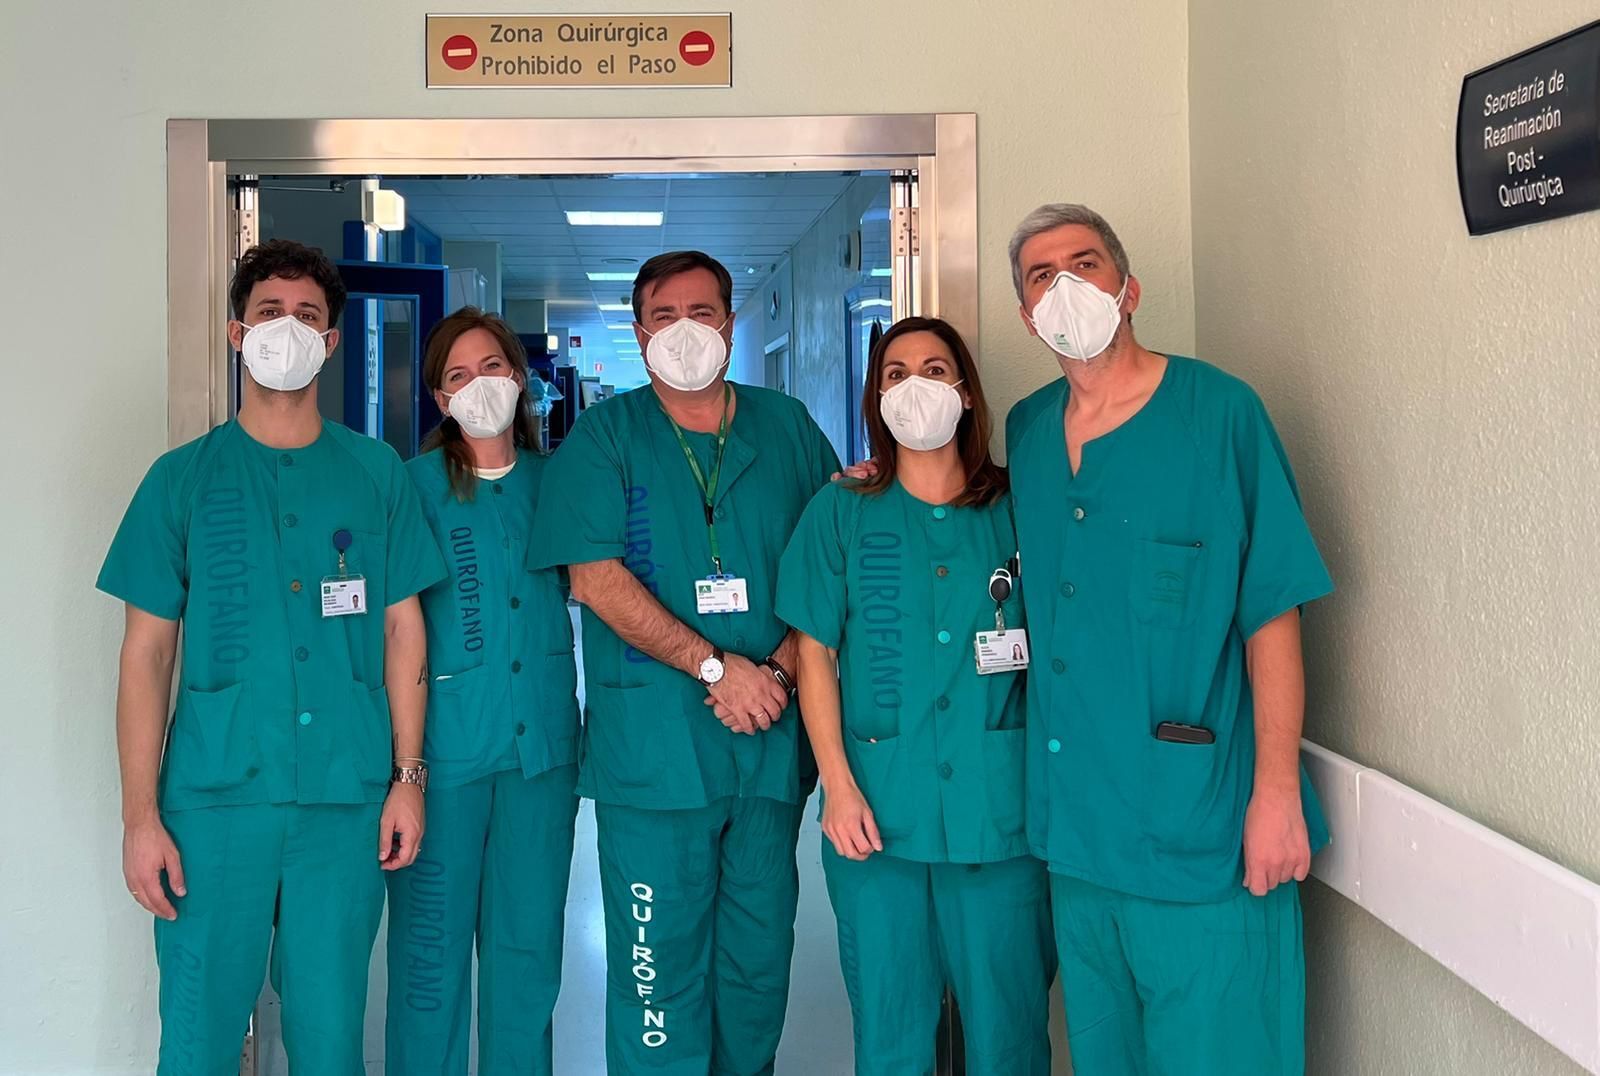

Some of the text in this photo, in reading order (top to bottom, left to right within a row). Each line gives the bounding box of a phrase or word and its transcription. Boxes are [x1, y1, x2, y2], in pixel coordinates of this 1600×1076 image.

[490, 22, 668, 47] Zona Quirúrgica
[481, 55, 676, 75] Prohibido el Paso
[1483, 69, 1565, 117] Secretaría de
[1484, 106, 1561, 149] Reanimación
[1499, 175, 1564, 208] Quirúrgica
[202, 487, 257, 665] QUIRÓFANO
[449, 526, 484, 653] QUIRÓFANO
[858, 531, 911, 710] QUIRÓFANO
[630, 882, 668, 1048] QUIRÓFNO
